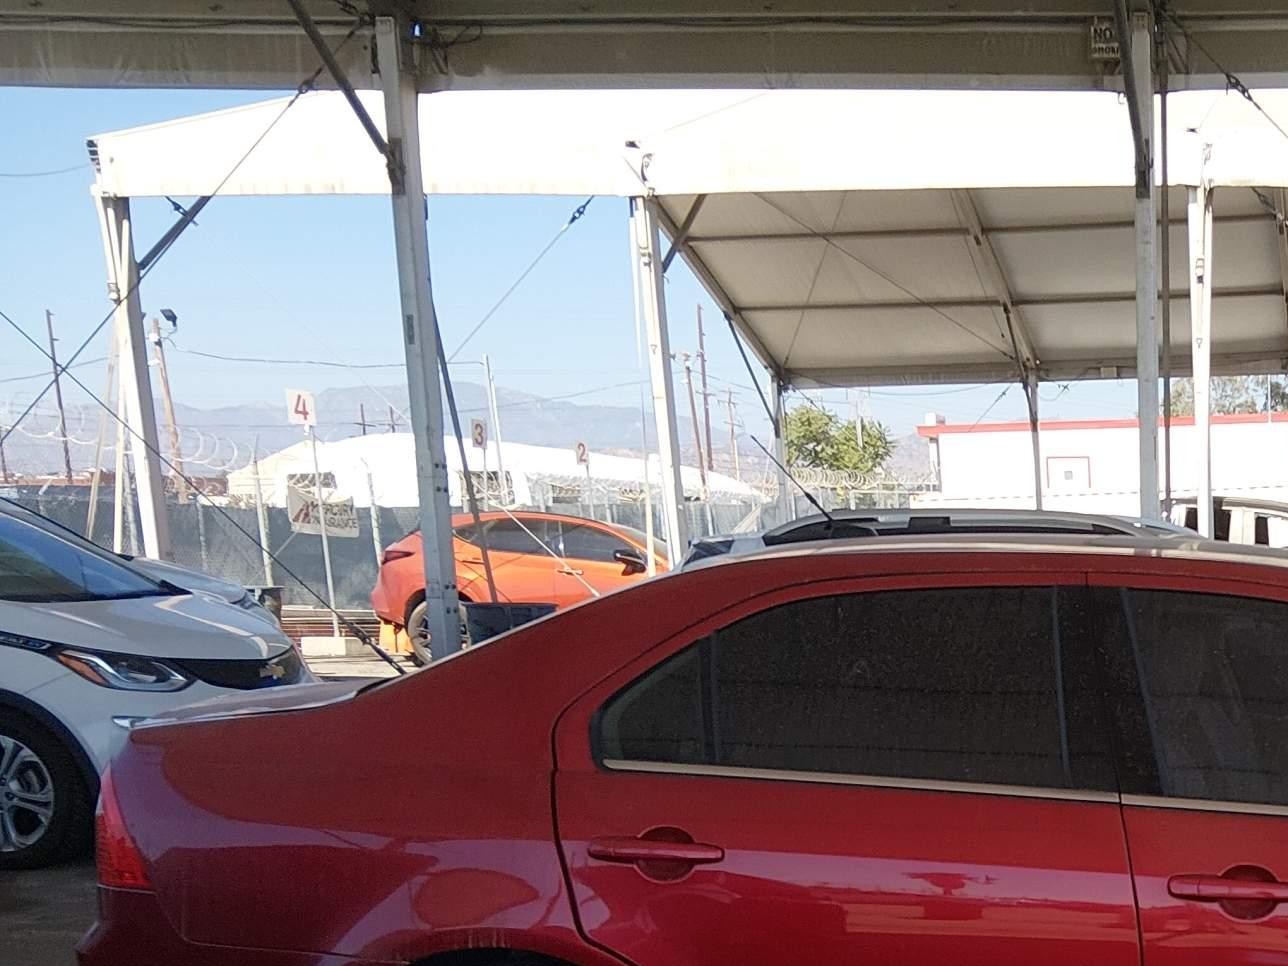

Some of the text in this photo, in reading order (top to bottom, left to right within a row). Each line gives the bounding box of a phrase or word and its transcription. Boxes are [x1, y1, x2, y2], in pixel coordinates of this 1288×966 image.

[1093, 26, 1113, 41] NO
[1091, 46, 1119, 55] SMOKI
[294, 394, 309, 420] 4
[474, 423, 484, 445] 3
[577, 442, 587, 463] 2
